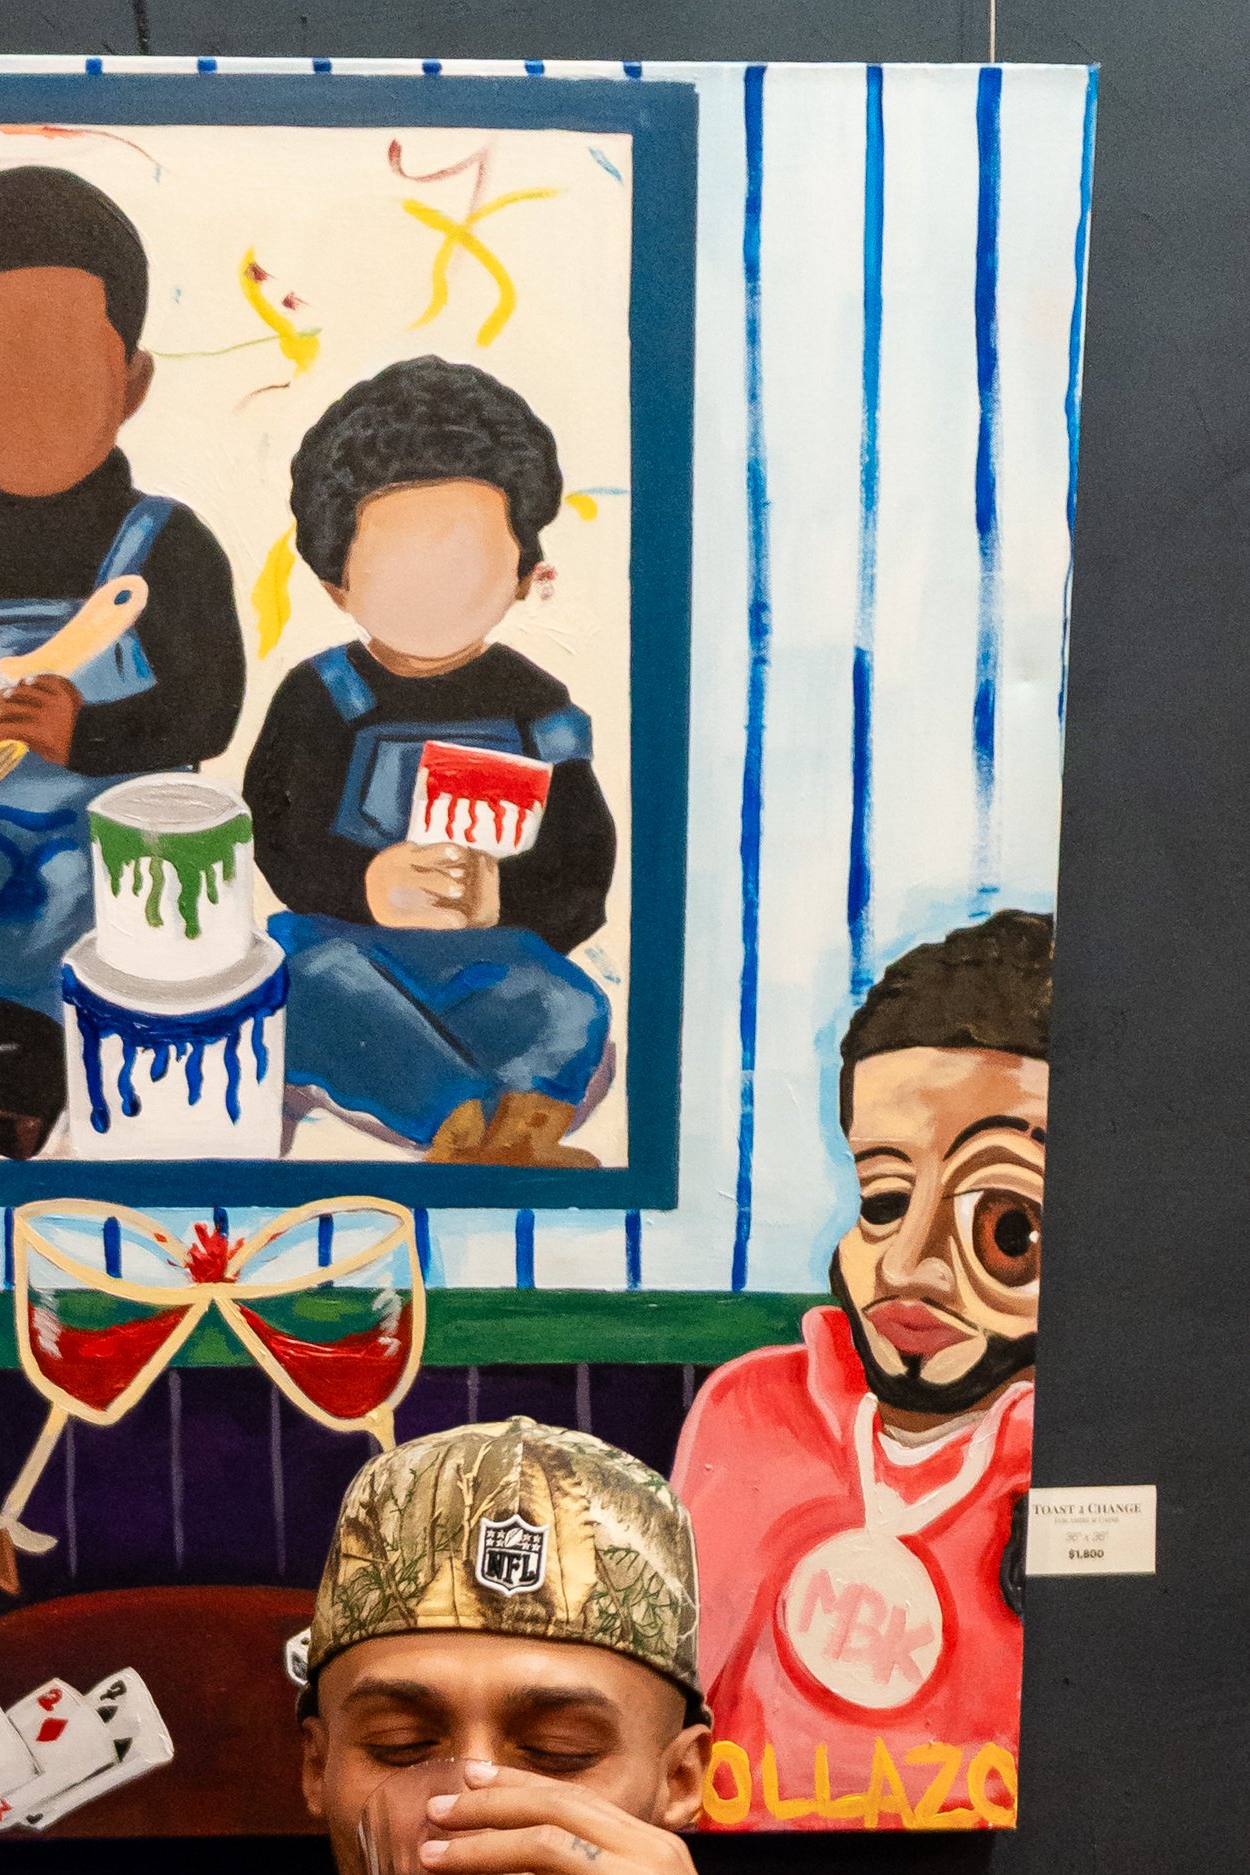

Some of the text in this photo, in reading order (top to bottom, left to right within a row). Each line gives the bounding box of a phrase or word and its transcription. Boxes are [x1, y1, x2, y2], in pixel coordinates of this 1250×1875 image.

[1032, 1503, 1076, 1515] TOAST
[1087, 1502, 1143, 1514] CHANGE
[485, 1550, 537, 1585] NFL
[690, 1735, 1018, 1832] OLLAZO
